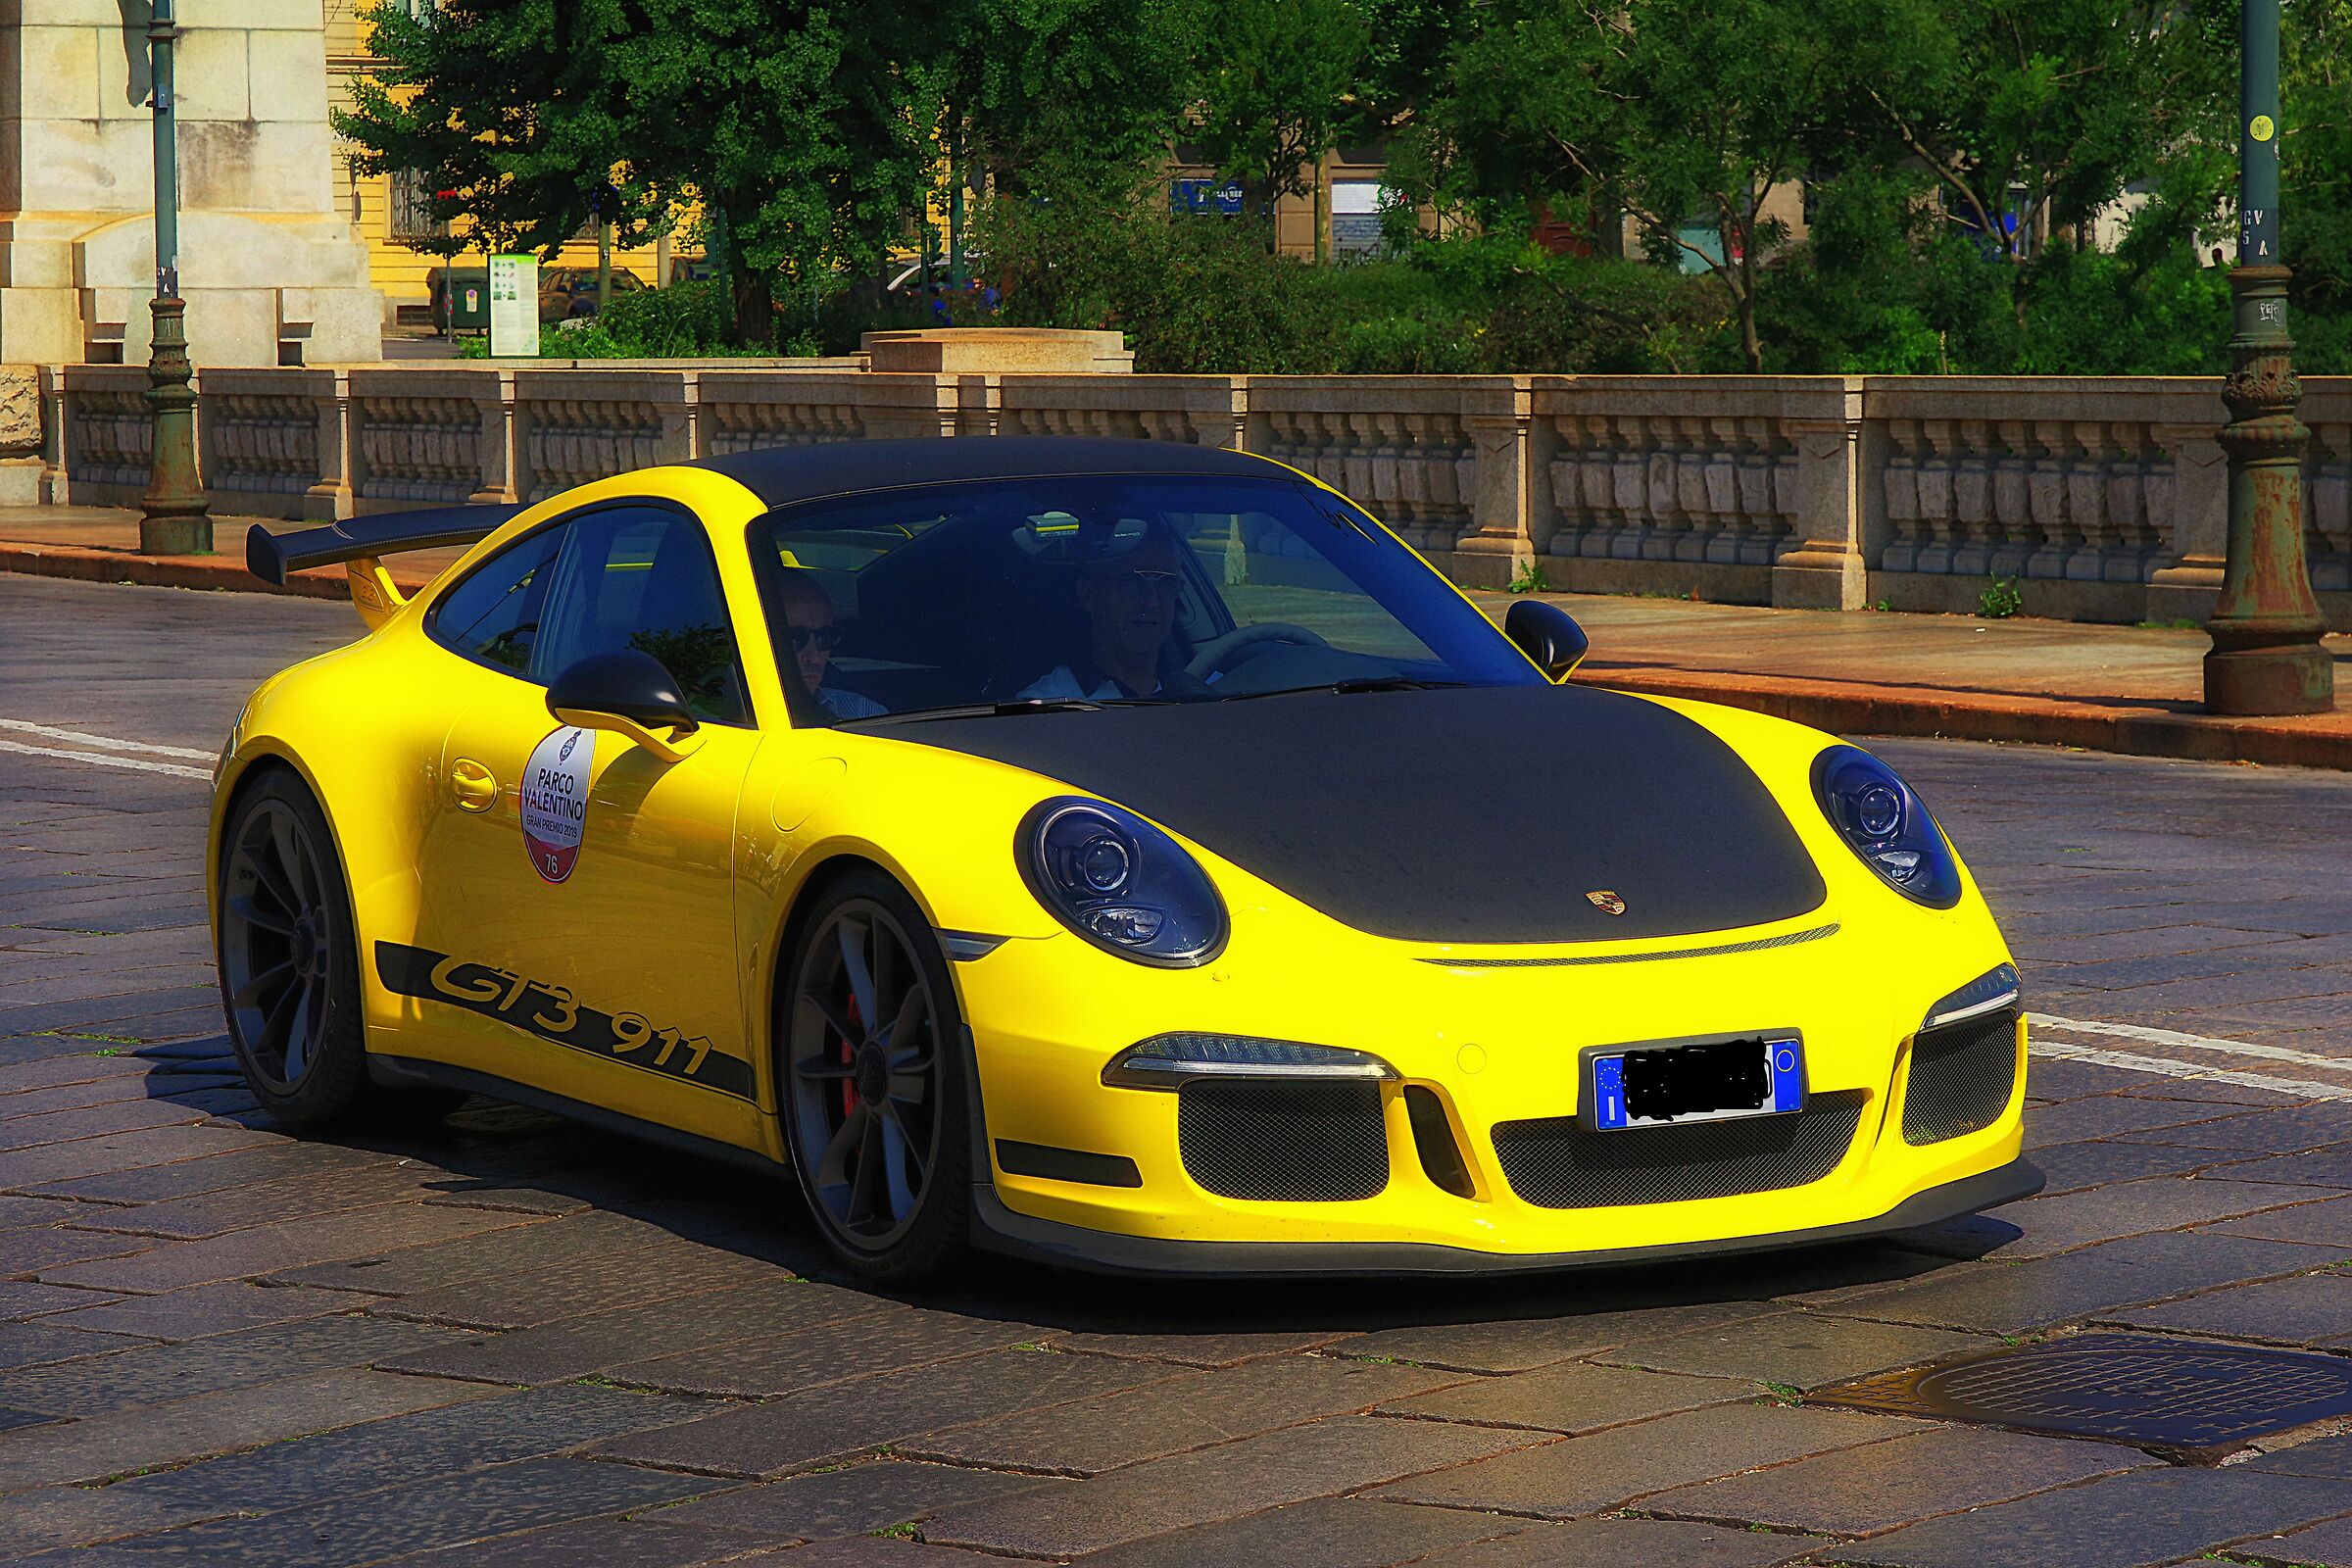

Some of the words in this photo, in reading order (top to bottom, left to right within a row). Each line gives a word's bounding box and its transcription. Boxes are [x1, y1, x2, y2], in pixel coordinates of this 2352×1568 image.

[538, 767, 574, 796] PARCO
[524, 786, 583, 821] VALENTINO
[526, 813, 542, 829] GRAN
[542, 818, 564, 835] PREMIO
[545, 854, 559, 874] 76
[430, 955, 580, 1033] GT3
[612, 1010, 712, 1075] 911
